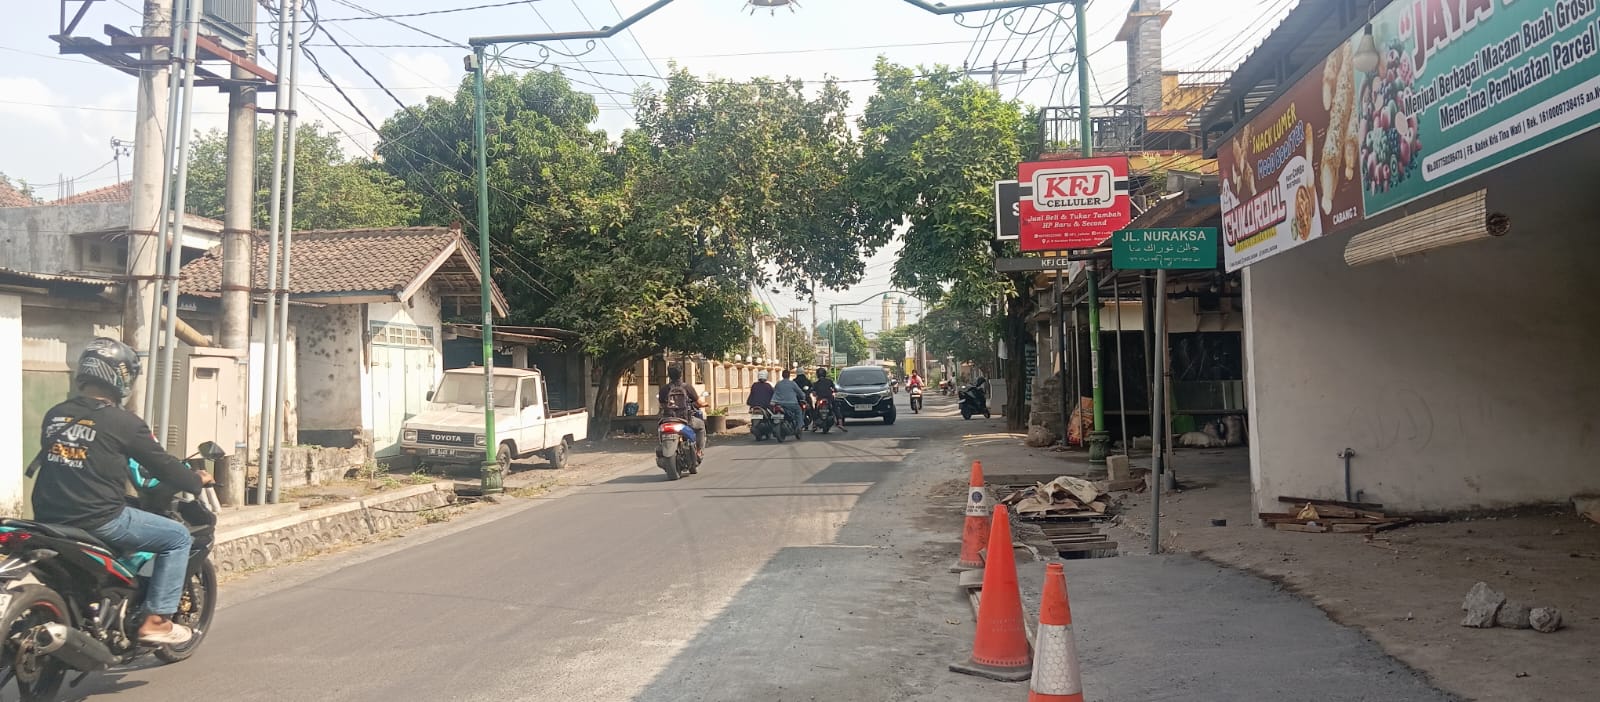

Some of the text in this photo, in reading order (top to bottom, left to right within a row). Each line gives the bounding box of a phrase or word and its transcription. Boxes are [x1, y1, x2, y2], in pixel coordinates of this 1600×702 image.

[1405, 79, 1437, 117] Menjual
[1439, 54, 1480, 98] Berbagai
[1482, 33, 1521, 73] Macam
[1523, 11, 1554, 49] Buah
[1440, 88, 1486, 129] Menerima
[1488, 56, 1551, 103] Pembuatan
[1553, 25, 1596, 70] Parcel
[1252, 102, 1297, 154] SNACK LUMER
[1044, 175, 1103, 198] KFJ
[1046, 197, 1101, 208] CELLULER
[1027, 214, 1044, 223] Jual
[1070, 212, 1091, 220] Tukar
[1093, 211, 1122, 219] Tambah
[1332, 206, 1357, 225] CABANG 2
[1122, 231, 1140, 242] JL.
[1143, 230, 1206, 241] NURAKSA
[1041, 259, 1055, 267] KFJ
[431, 434, 462, 442] TOYOTA
